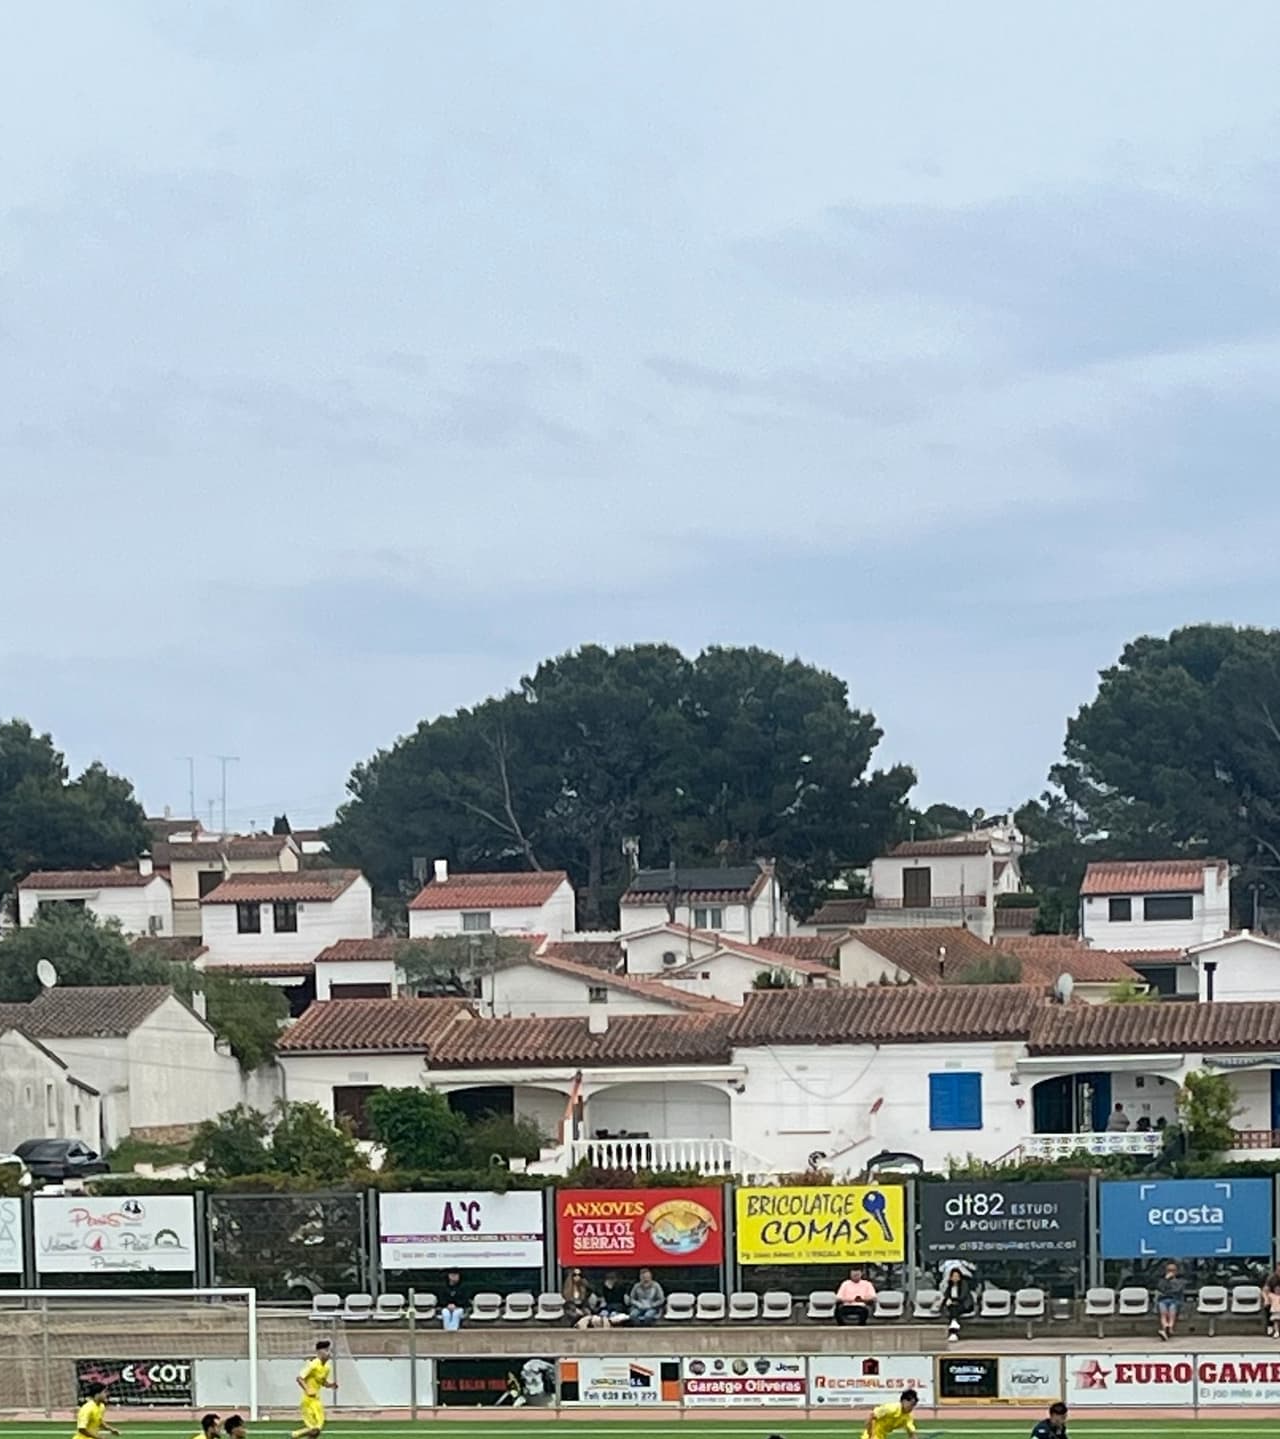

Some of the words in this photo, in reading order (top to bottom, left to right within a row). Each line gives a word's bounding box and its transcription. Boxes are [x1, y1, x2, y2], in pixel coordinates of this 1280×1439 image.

[563, 1201, 646, 1218] ANXOVES
[746, 1193, 854, 1217] BRICOLATGE
[945, 1192, 1005, 1217] dt82
[1010, 1202, 1059, 1216] ESTUDI
[1147, 1204, 1225, 1227] ecosta
[572, 1222, 635, 1236] CALLOL
[760, 1218, 871, 1245] COMAS
[943, 1218, 1060, 1233] D'ARQUITECTURA
[572, 1236, 635, 1250] SERRATS
[121, 1364, 190, 1386] ESCOT
[775, 1363, 800, 1374] Jeep
[1114, 1363, 1193, 1384] EURO
[687, 1380, 743, 1394] Garatge
[745, 1379, 802, 1393] Oliveras
